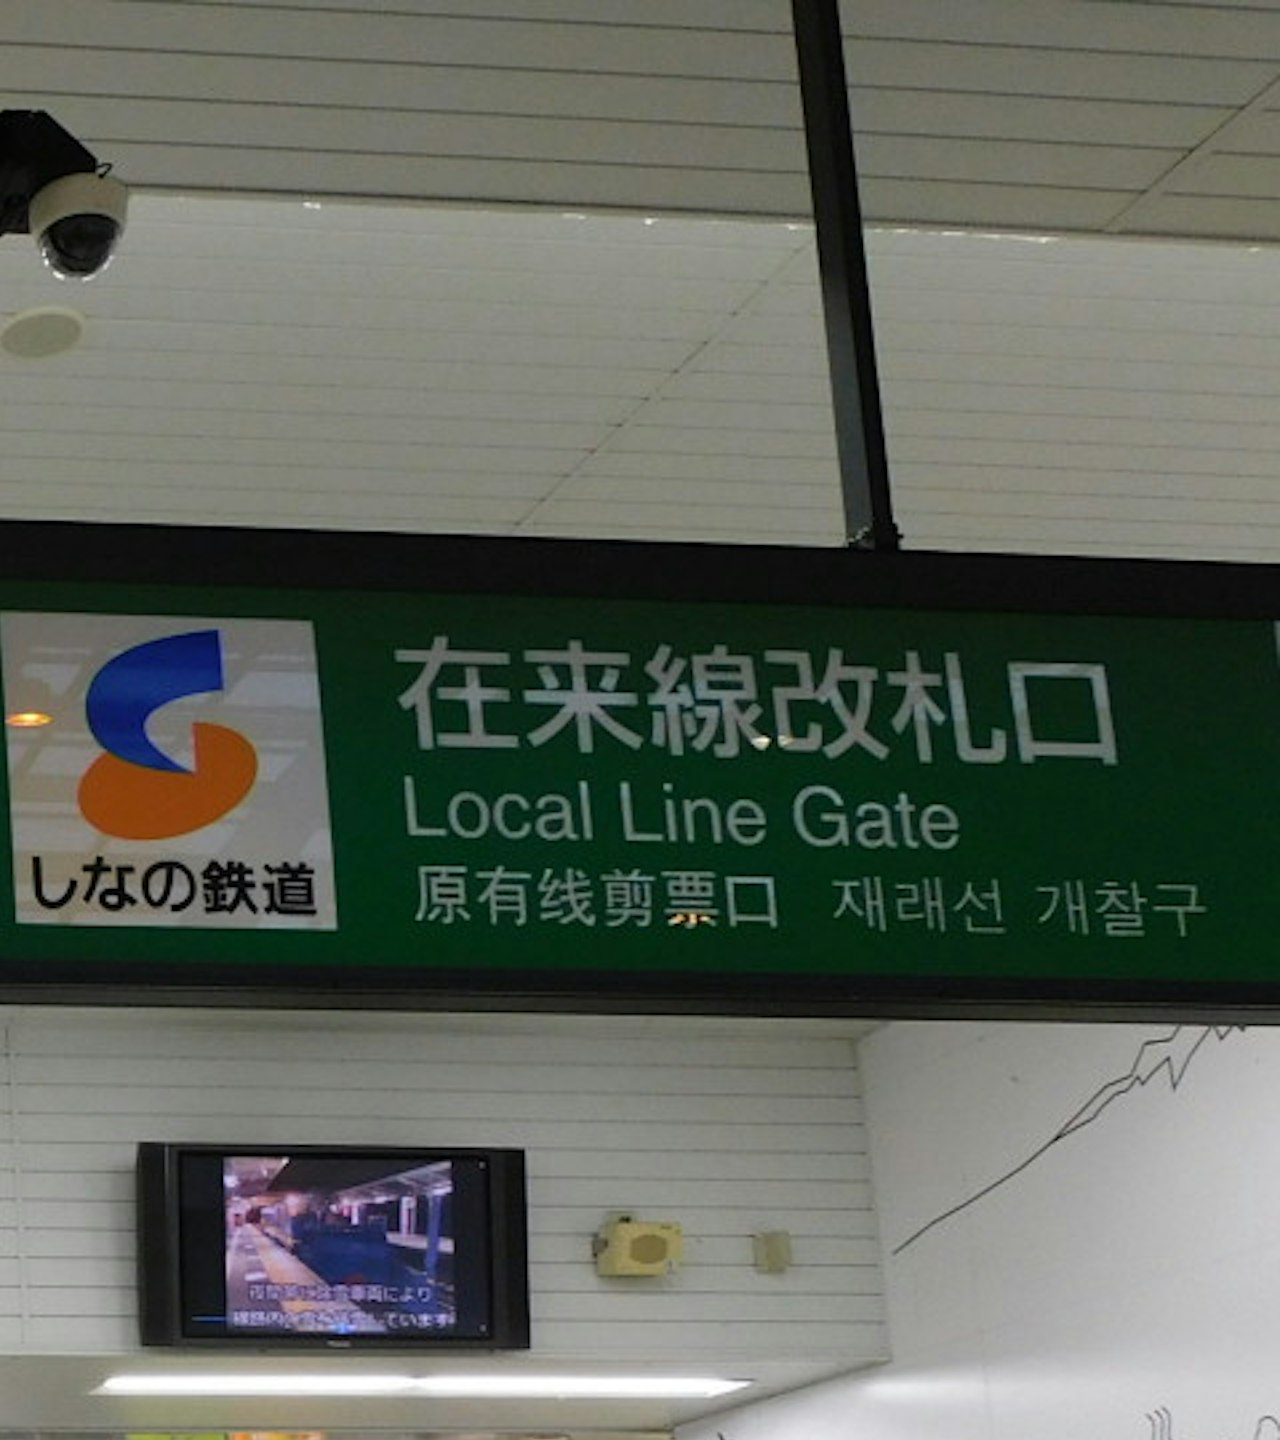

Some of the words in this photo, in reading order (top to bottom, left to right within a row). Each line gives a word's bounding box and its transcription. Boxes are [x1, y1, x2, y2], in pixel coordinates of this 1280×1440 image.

[393, 636, 1119, 767] 在来線改札口
[405, 776, 592, 846] Local
[621, 781, 767, 847] Line
[791, 784, 962, 852] Gate
[30, 854, 319, 920] しなの鉄道
[414, 864, 780, 929] 原有线剪票口
[833, 875, 1007, 934] 재래선
[1037, 877, 1209, 938] 개찰구
